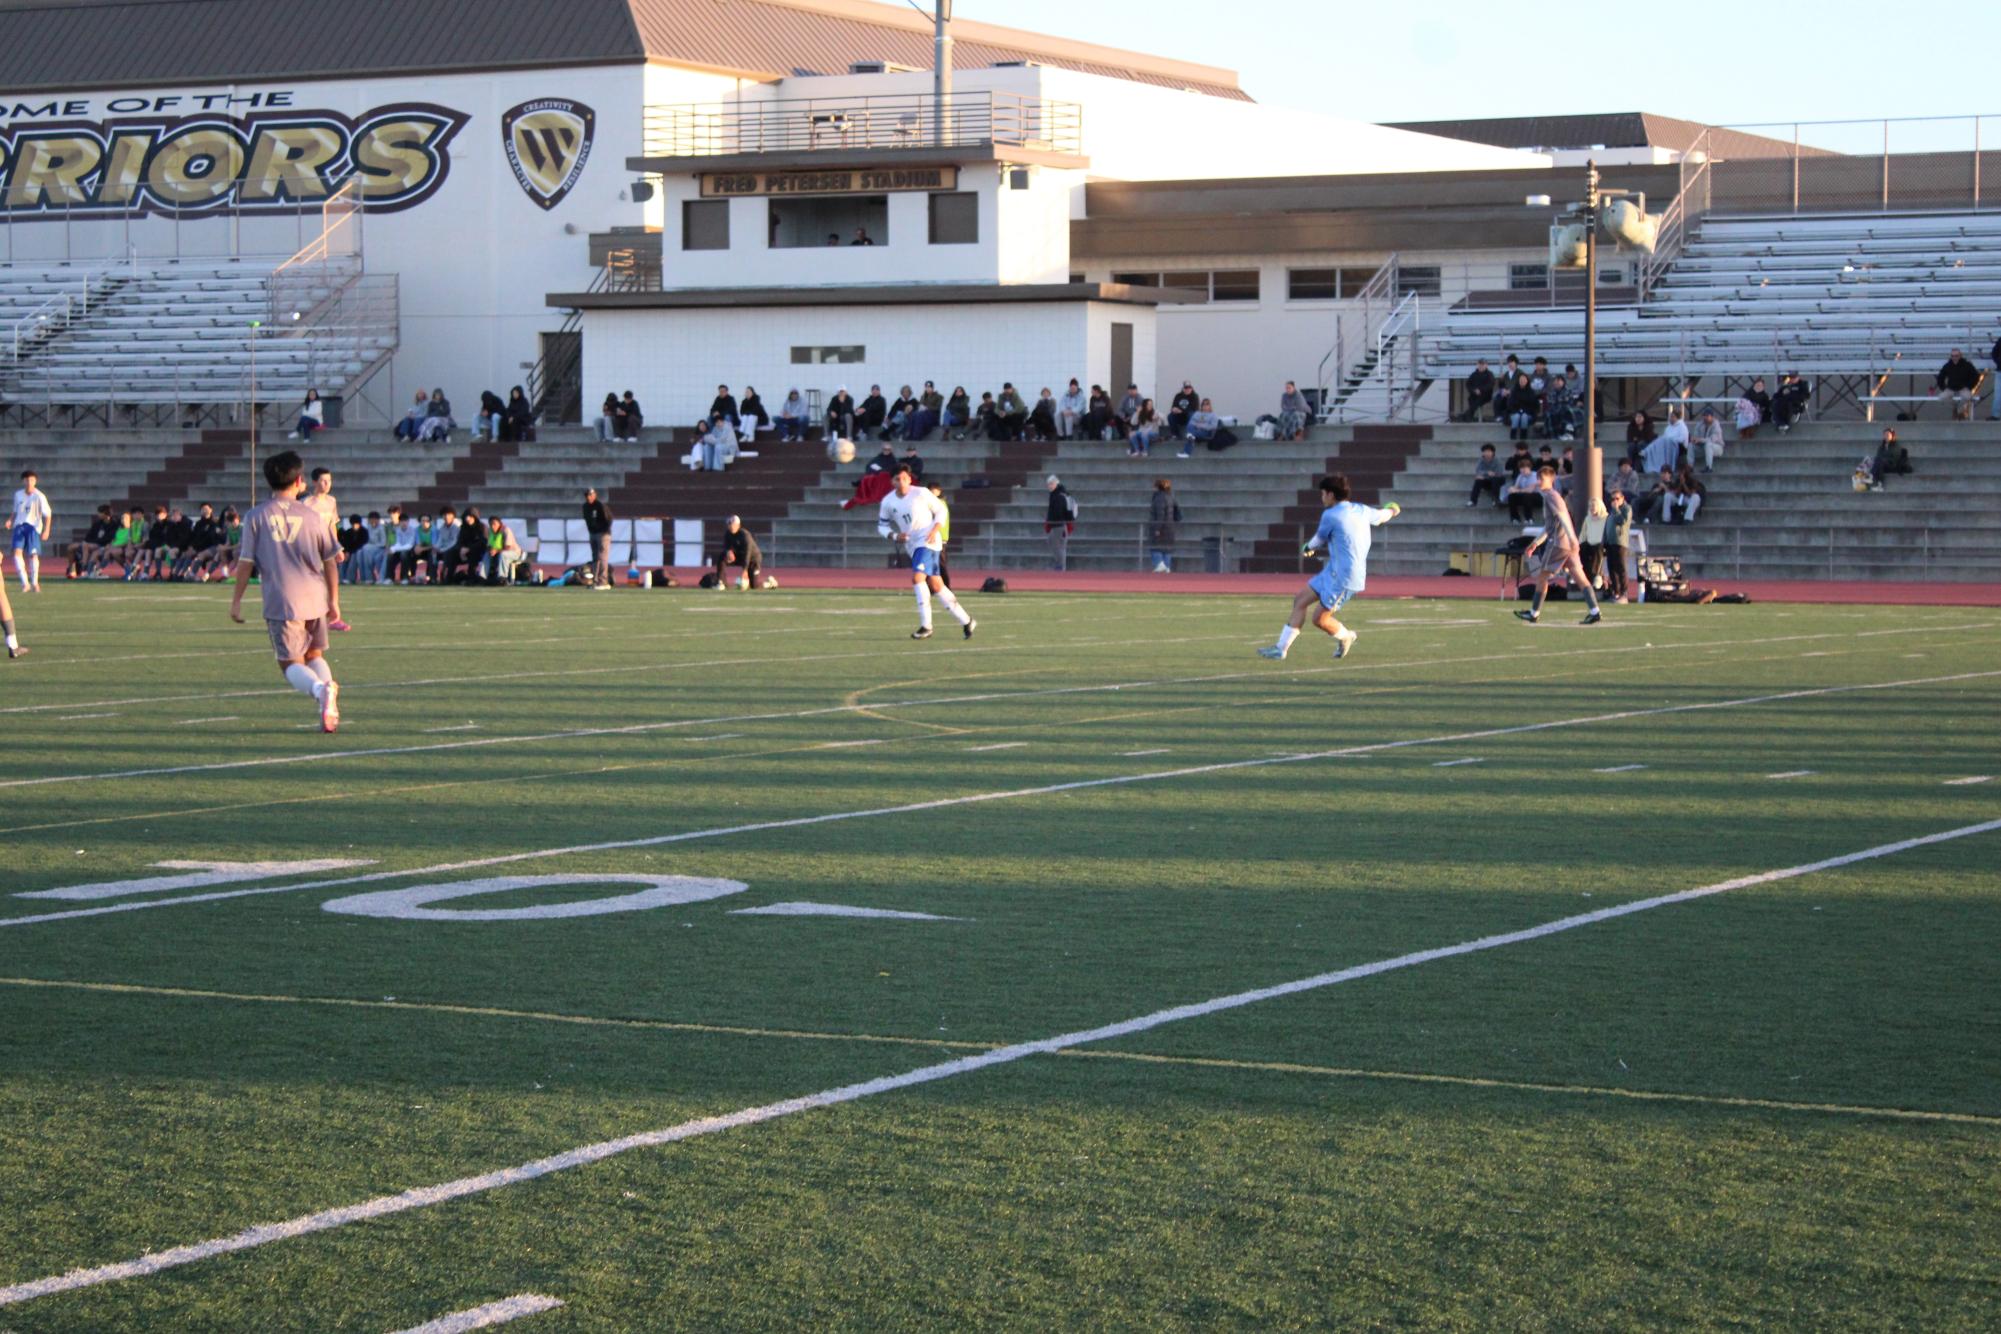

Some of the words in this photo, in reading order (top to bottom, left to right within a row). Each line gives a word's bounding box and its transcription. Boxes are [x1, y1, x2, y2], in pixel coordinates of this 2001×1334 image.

[106, 97, 183, 113] OF
[192, 91, 294, 110] THE
[523, 101, 574, 113] CREATIVITY
[0, 103, 471, 219] RIORS
[505, 139, 533, 192] CHARACTER
[520, 127, 575, 173] W
[562, 140, 591, 191] RESILIENCE
[713, 174, 757, 193] FRED
[765, 172, 851, 191] PETERSEN
[860, 169, 941, 189] STADIUM
